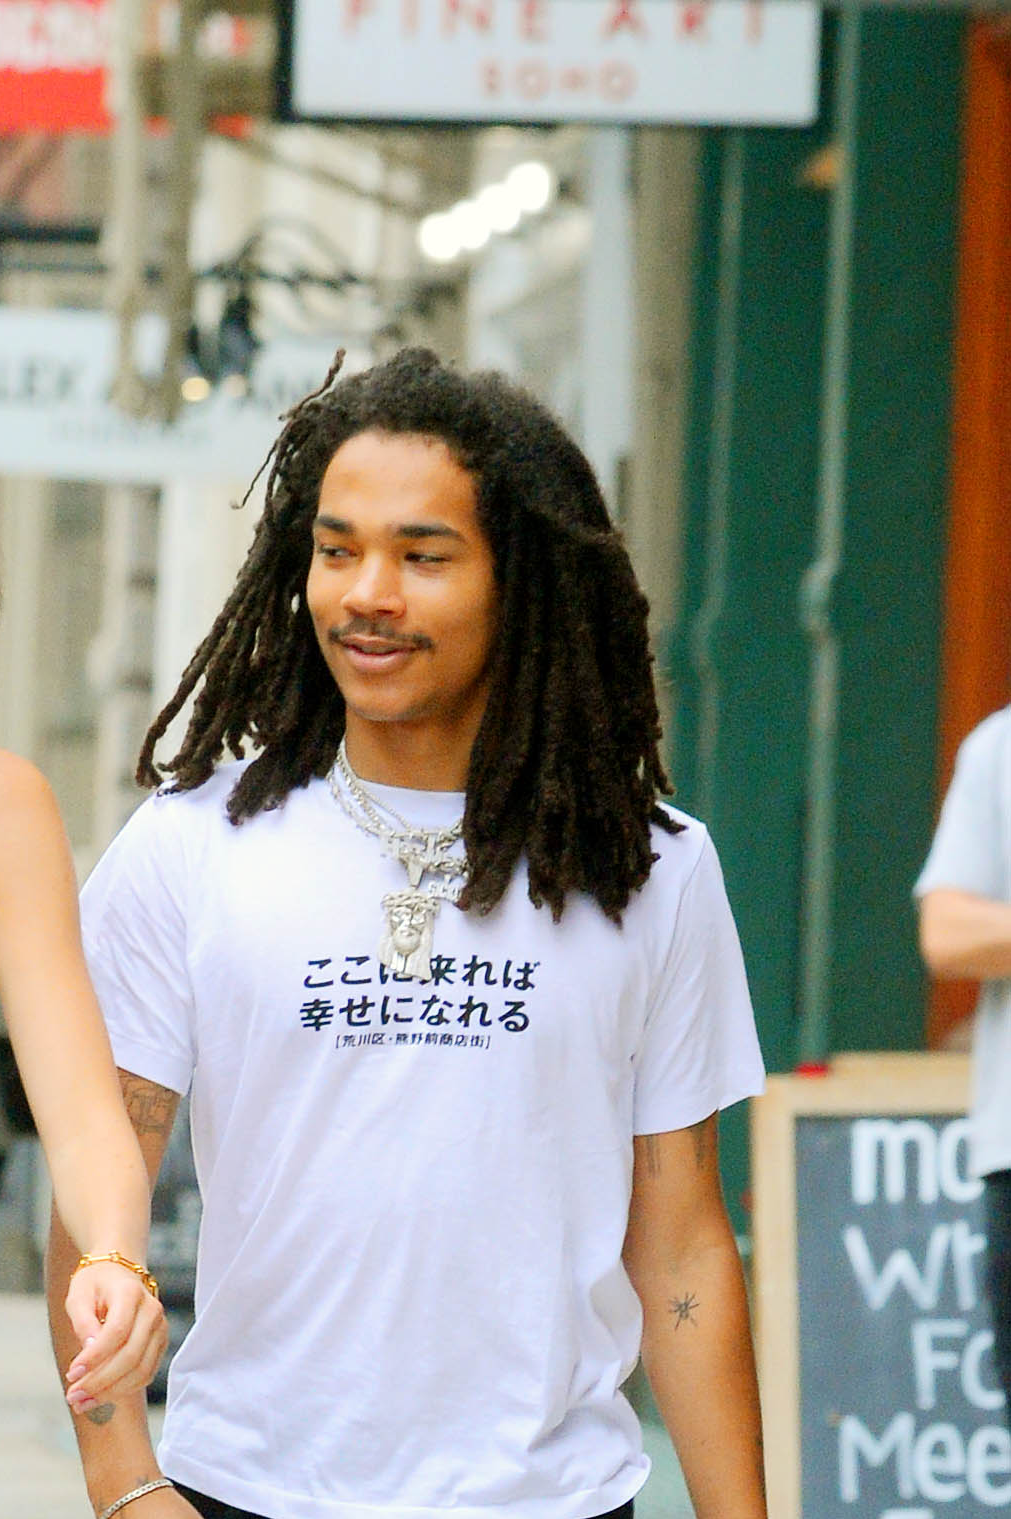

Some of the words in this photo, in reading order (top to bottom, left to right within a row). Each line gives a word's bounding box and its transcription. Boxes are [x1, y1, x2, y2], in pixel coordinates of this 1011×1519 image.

[299, 994, 530, 1033] 幸せになれる
